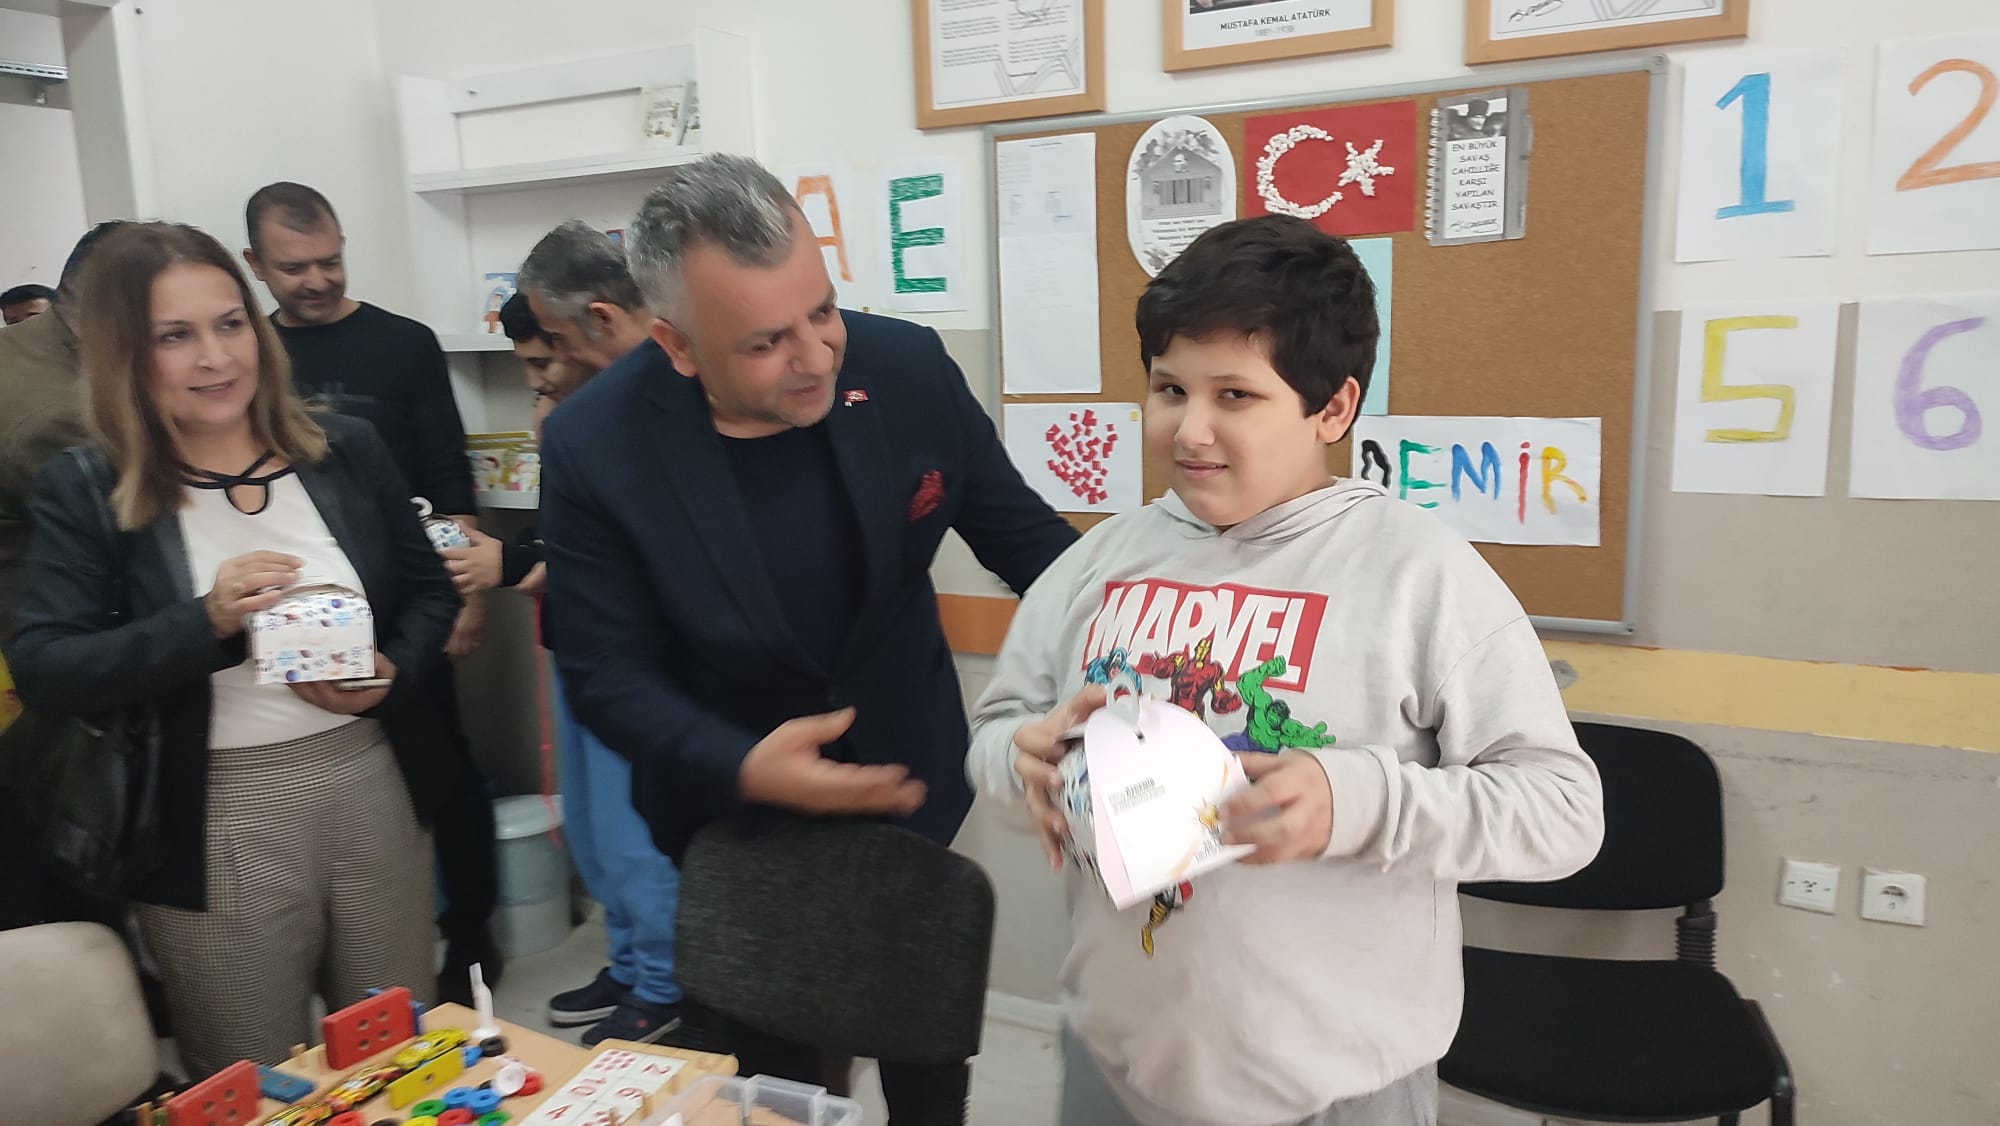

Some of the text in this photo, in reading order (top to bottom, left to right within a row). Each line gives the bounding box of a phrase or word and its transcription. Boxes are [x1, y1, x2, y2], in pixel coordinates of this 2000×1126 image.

[1220, 18, 1259, 31] MUSTAFA
[1260, 14, 1289, 26] KEMAL
[1291, 8, 1331, 21] ATATÜRK
[1452, 143, 1466, 153] EN
[1715, 72, 1795, 219] 1
[1896, 58, 2000, 192] 2
[1455, 190, 1495, 198] YAPILAN
[888, 173, 947, 294] E
[1701, 315, 1798, 443] 5
[1893, 315, 1988, 451] 6
[1086, 583, 1306, 685] MARVEL
[569, 1076, 607, 1096] 10
[642, 1062, 673, 1076] 2
[546, 1103, 573, 1121] 4
